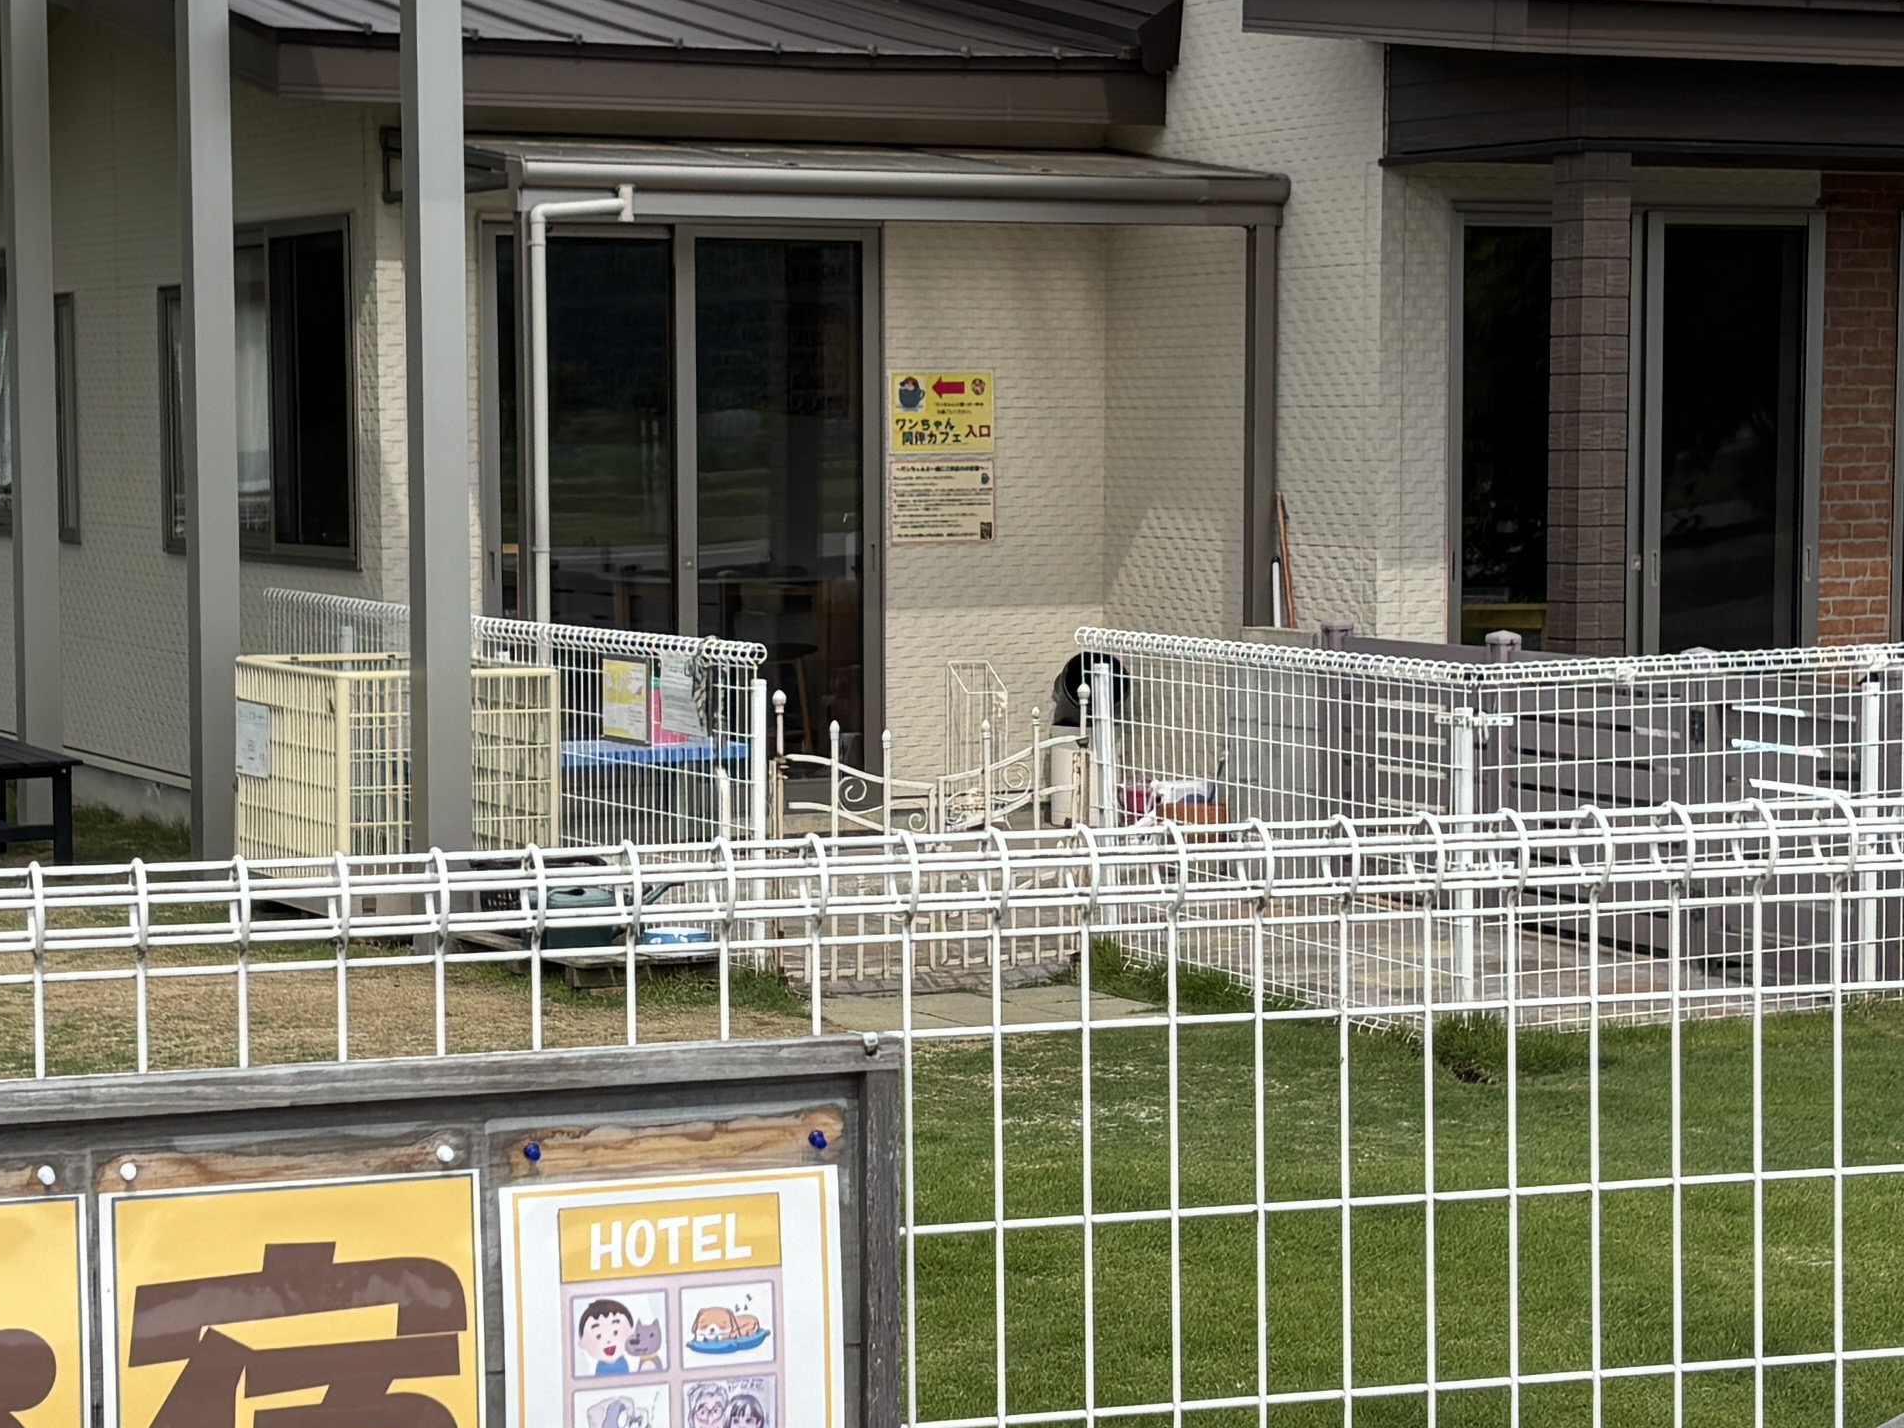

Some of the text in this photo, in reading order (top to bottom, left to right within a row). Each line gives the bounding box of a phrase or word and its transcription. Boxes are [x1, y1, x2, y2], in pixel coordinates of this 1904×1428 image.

[895, 417, 955, 431] ワンちゃん
[965, 424, 991, 438] 入口
[590, 1212, 752, 1271] HOTEL
